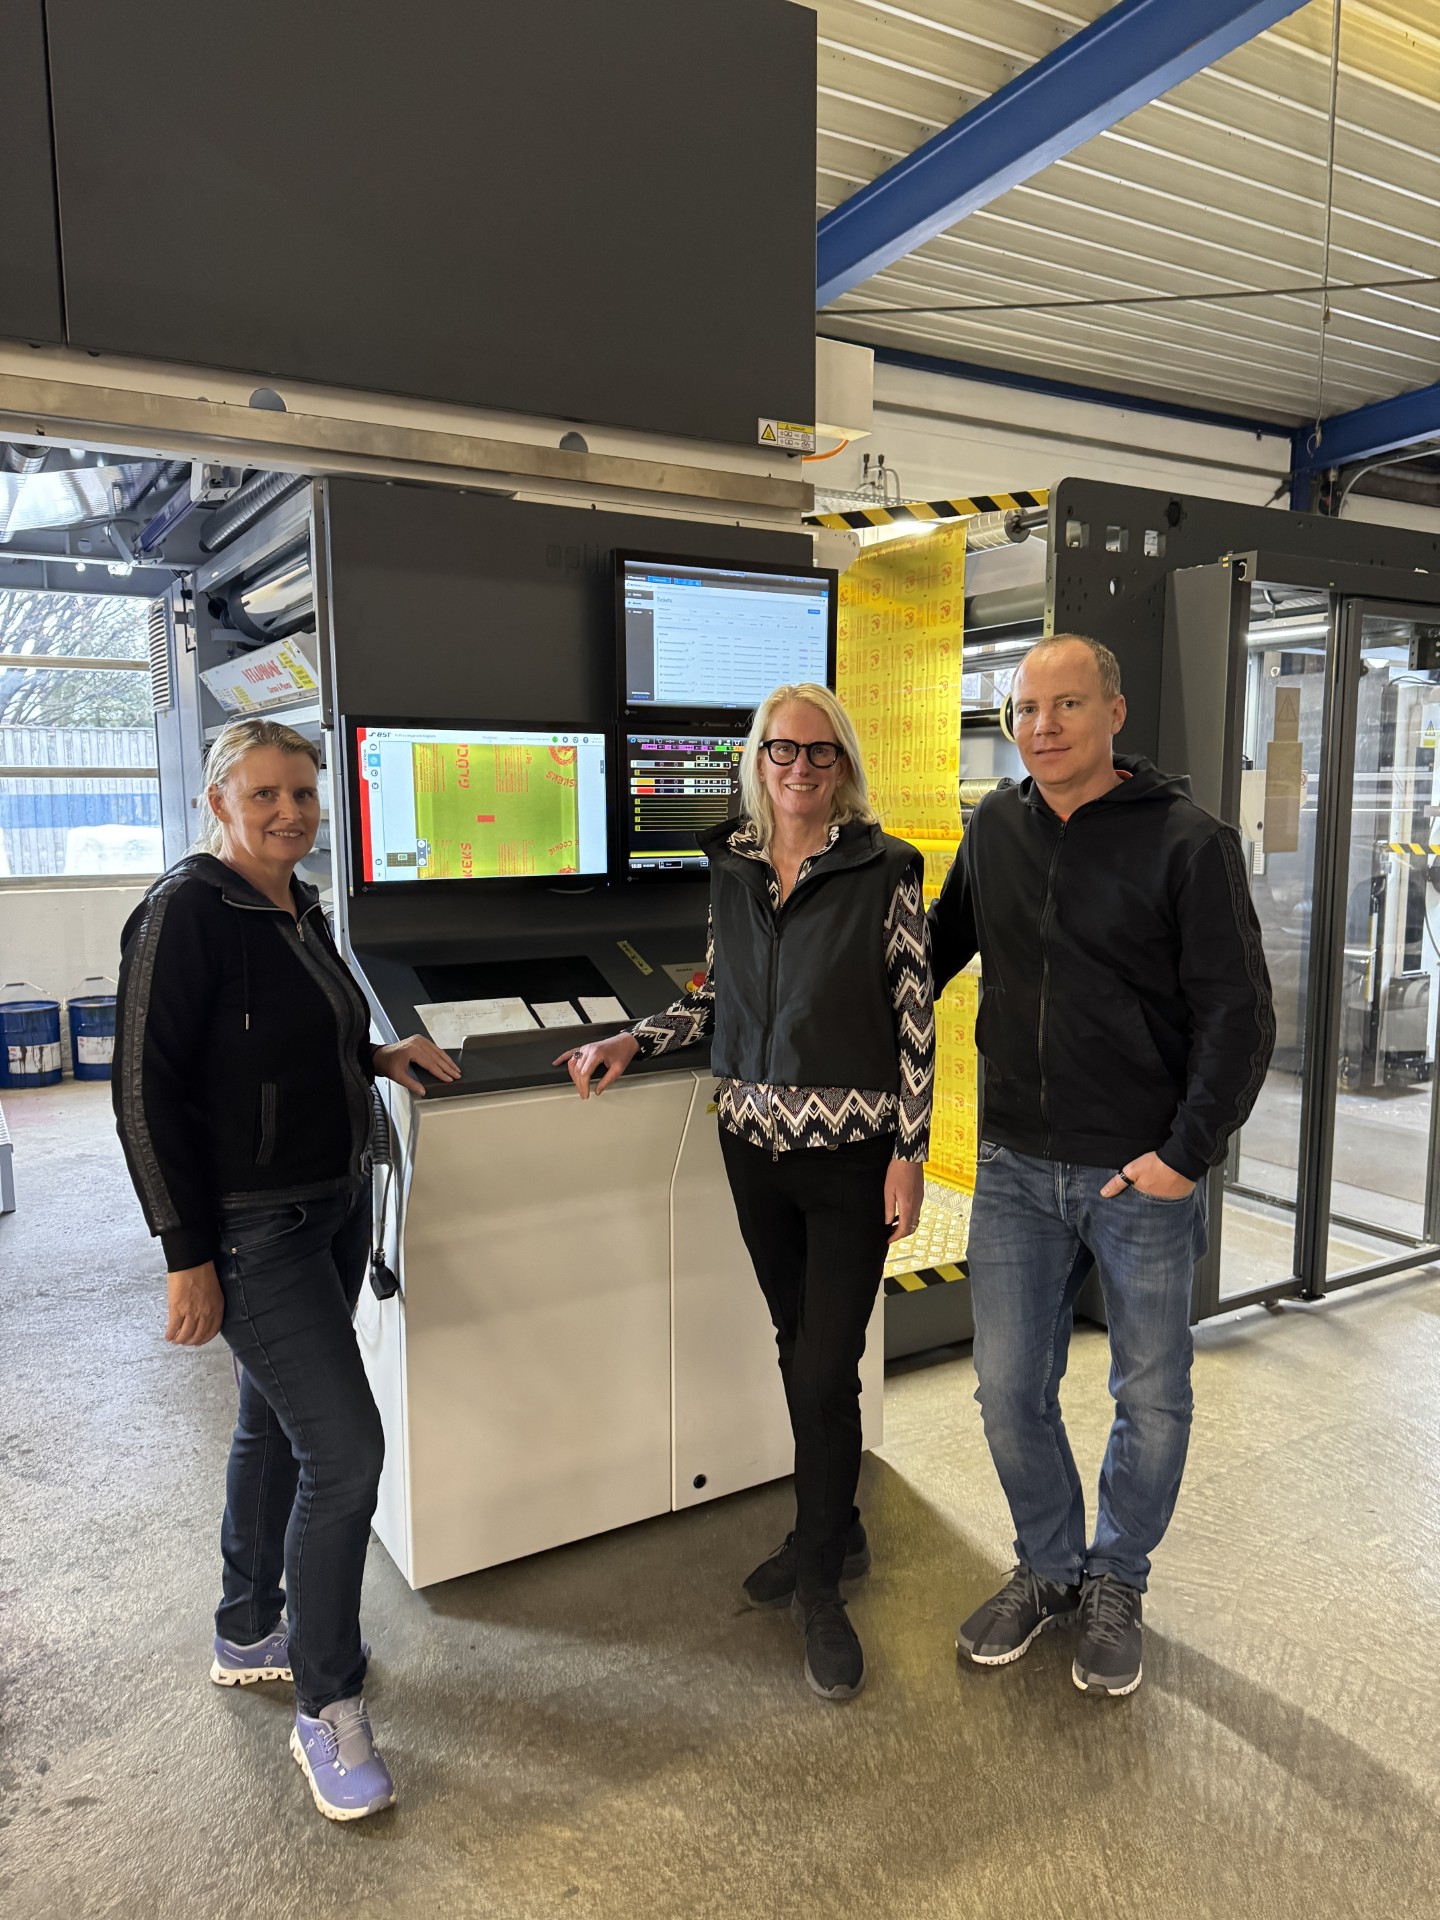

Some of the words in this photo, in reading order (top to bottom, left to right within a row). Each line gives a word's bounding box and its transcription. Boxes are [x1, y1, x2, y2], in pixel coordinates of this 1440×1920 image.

[546, 543, 610, 576] opti
[456, 744, 470, 789] GLÜC
[461, 842, 473, 877] KEKS
